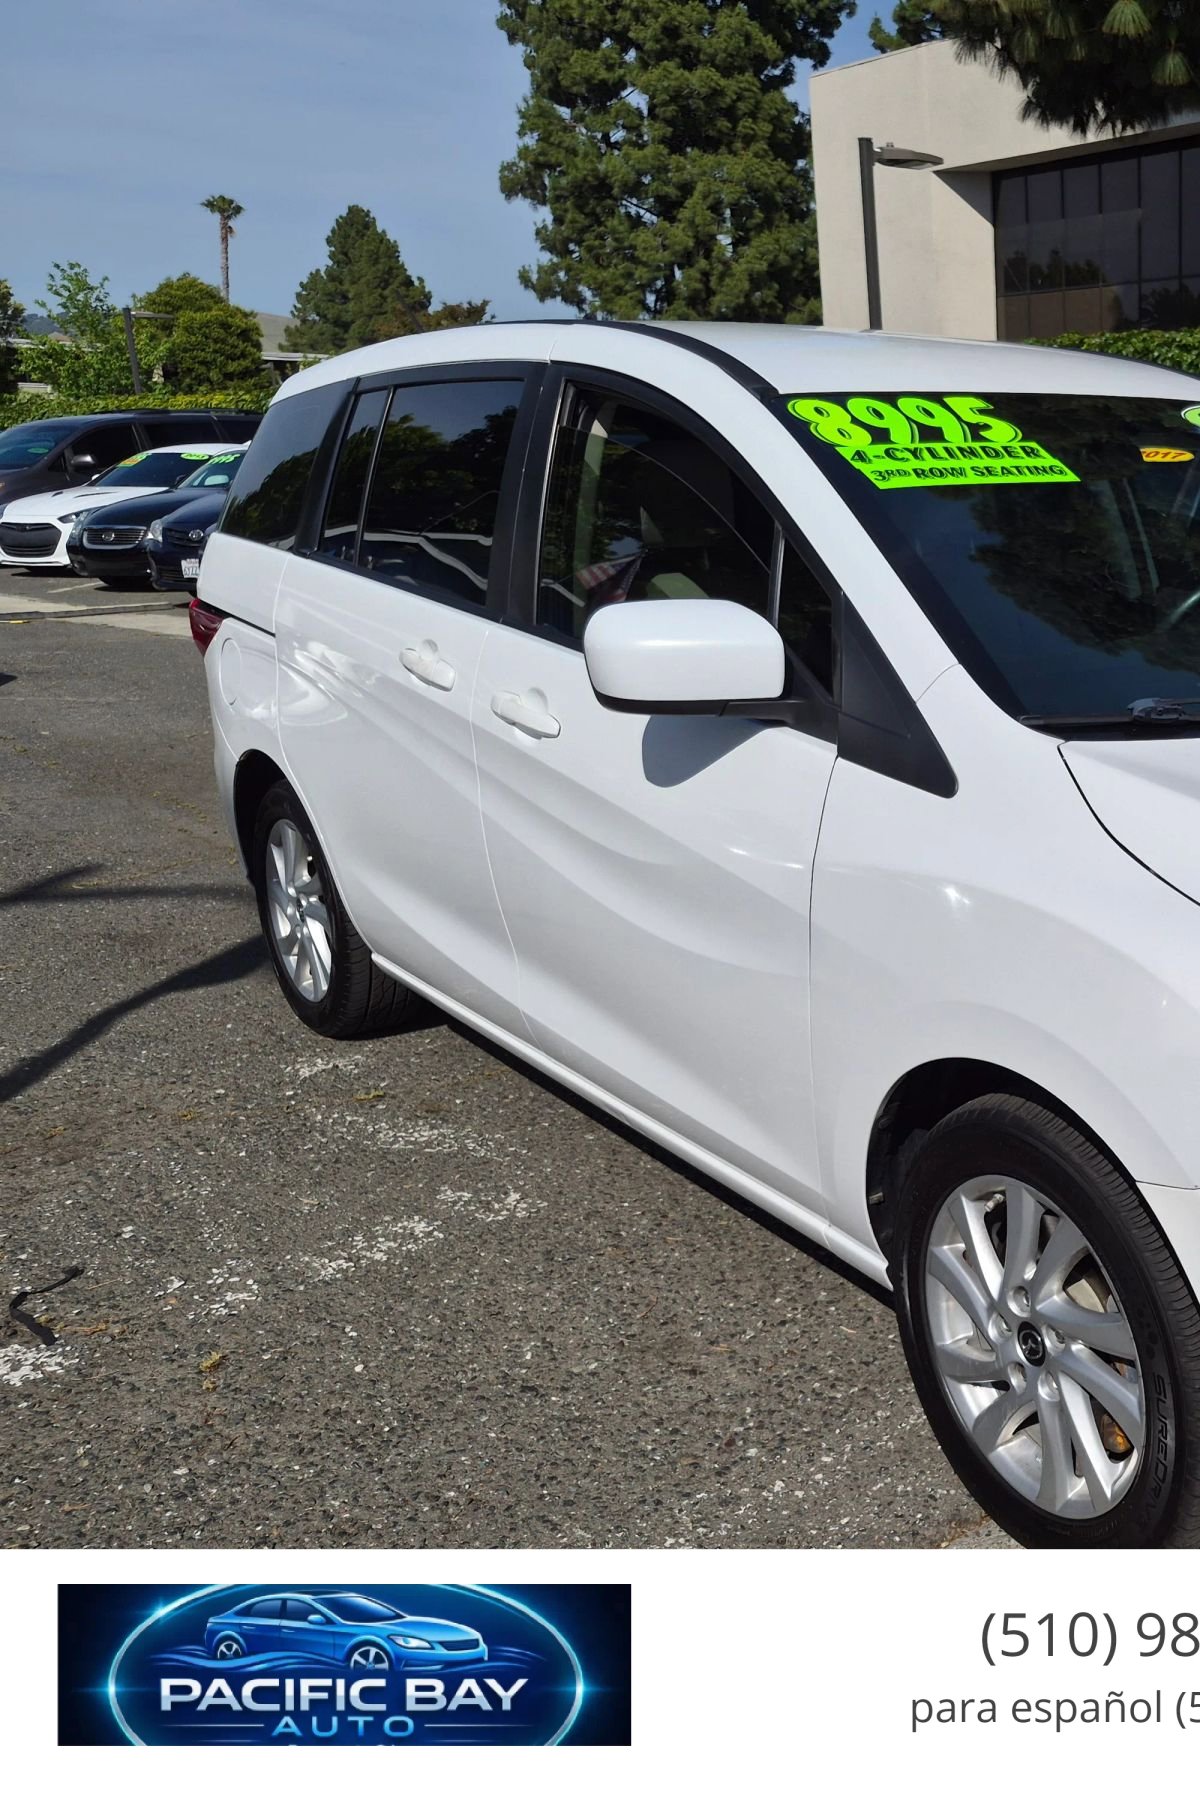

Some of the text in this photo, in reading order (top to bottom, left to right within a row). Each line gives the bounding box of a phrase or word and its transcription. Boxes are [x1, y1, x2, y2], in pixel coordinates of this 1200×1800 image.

[788, 397, 1023, 447] 8995
[850, 445, 1048, 465] 4-CYLINDER
[911, 467, 967, 480] ROW
[973, 465, 1066, 478] SEATING
